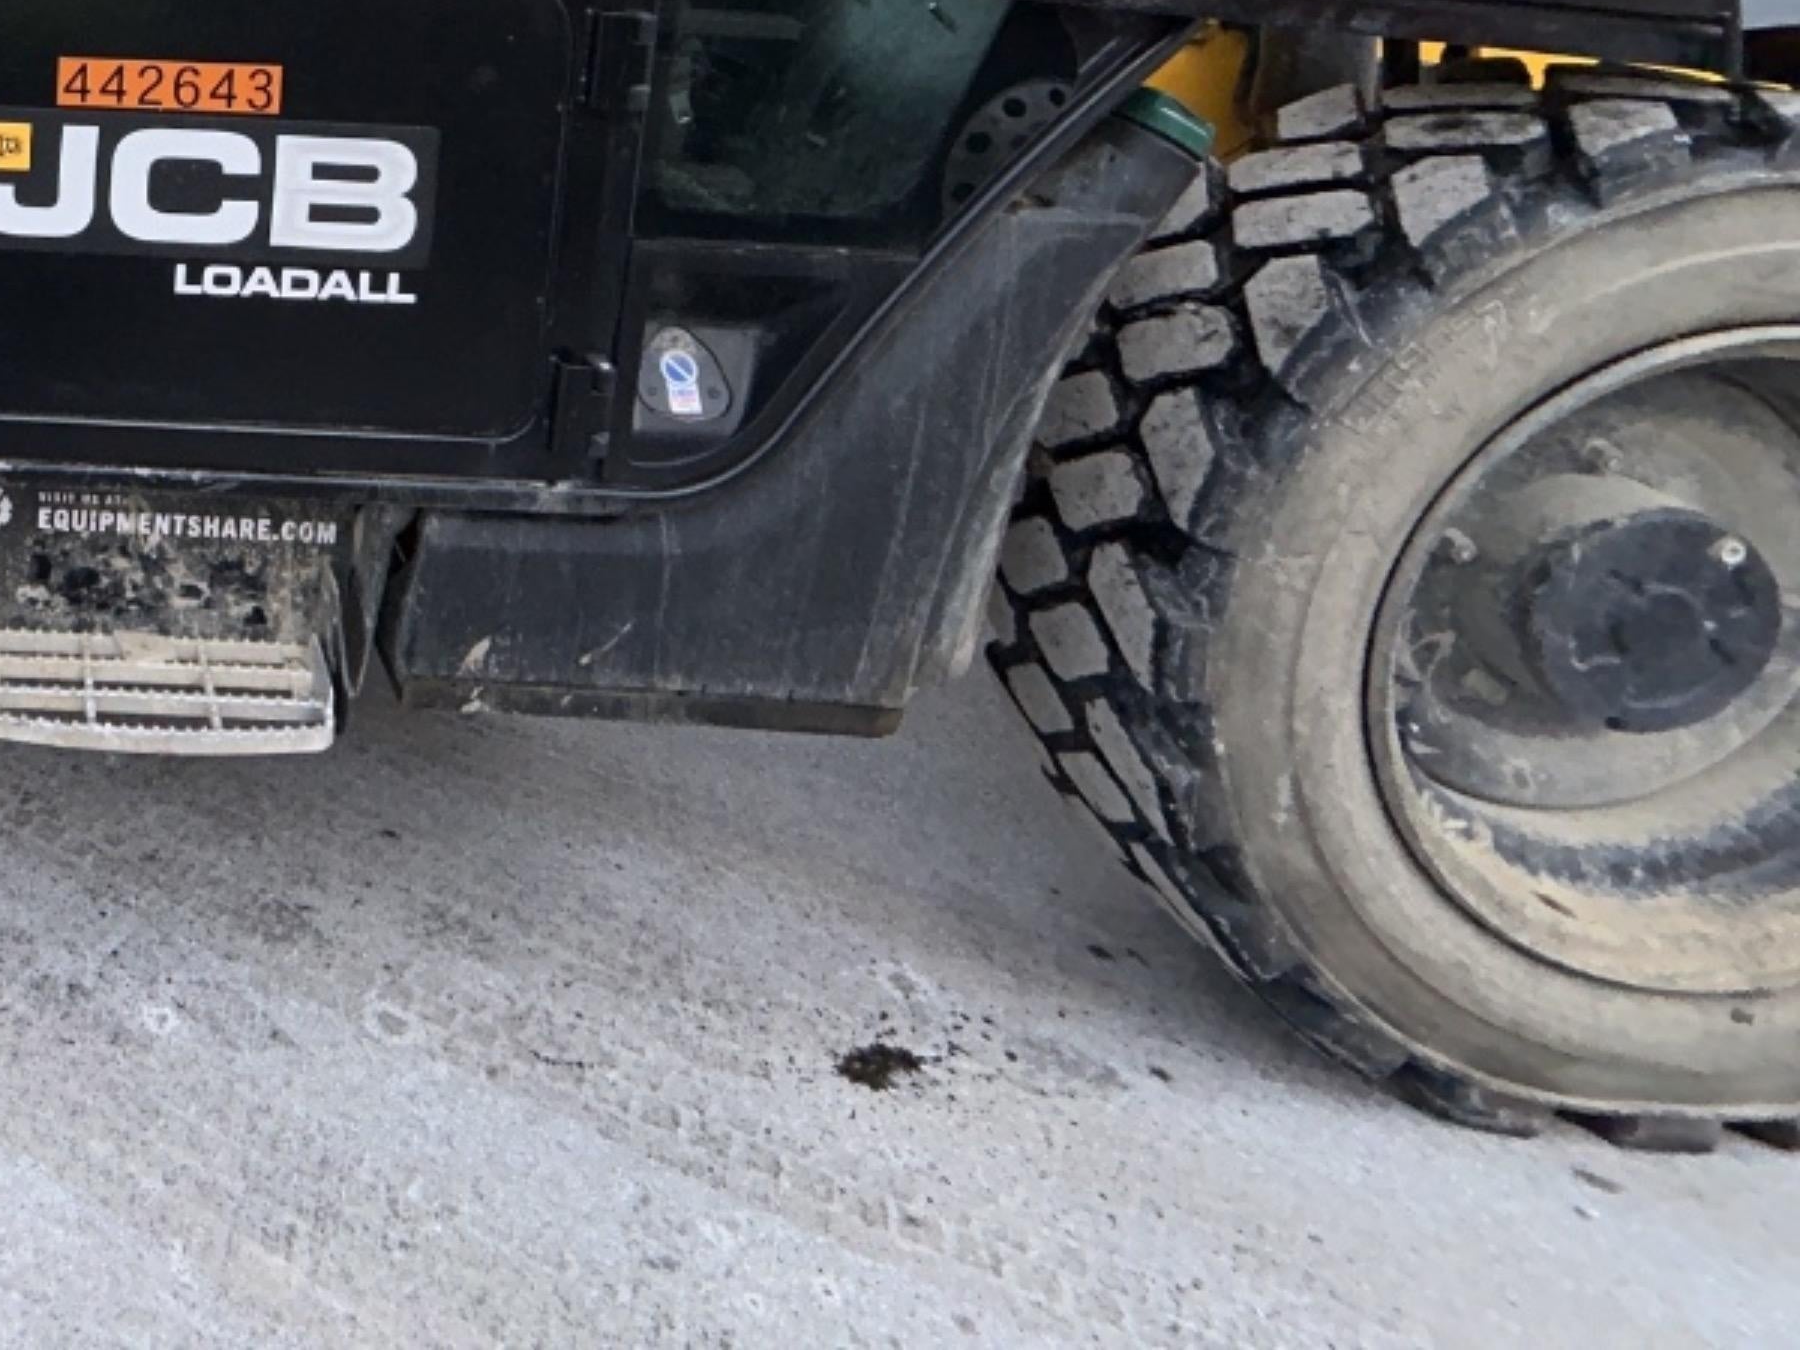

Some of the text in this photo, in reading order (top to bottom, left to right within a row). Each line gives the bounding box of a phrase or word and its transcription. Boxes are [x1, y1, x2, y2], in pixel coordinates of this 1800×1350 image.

[63, 63, 275, 110] 442643
[174, 263, 417, 305] LOADALL
[38, 507, 337, 544] EQUIPMENTSHARE.COM
